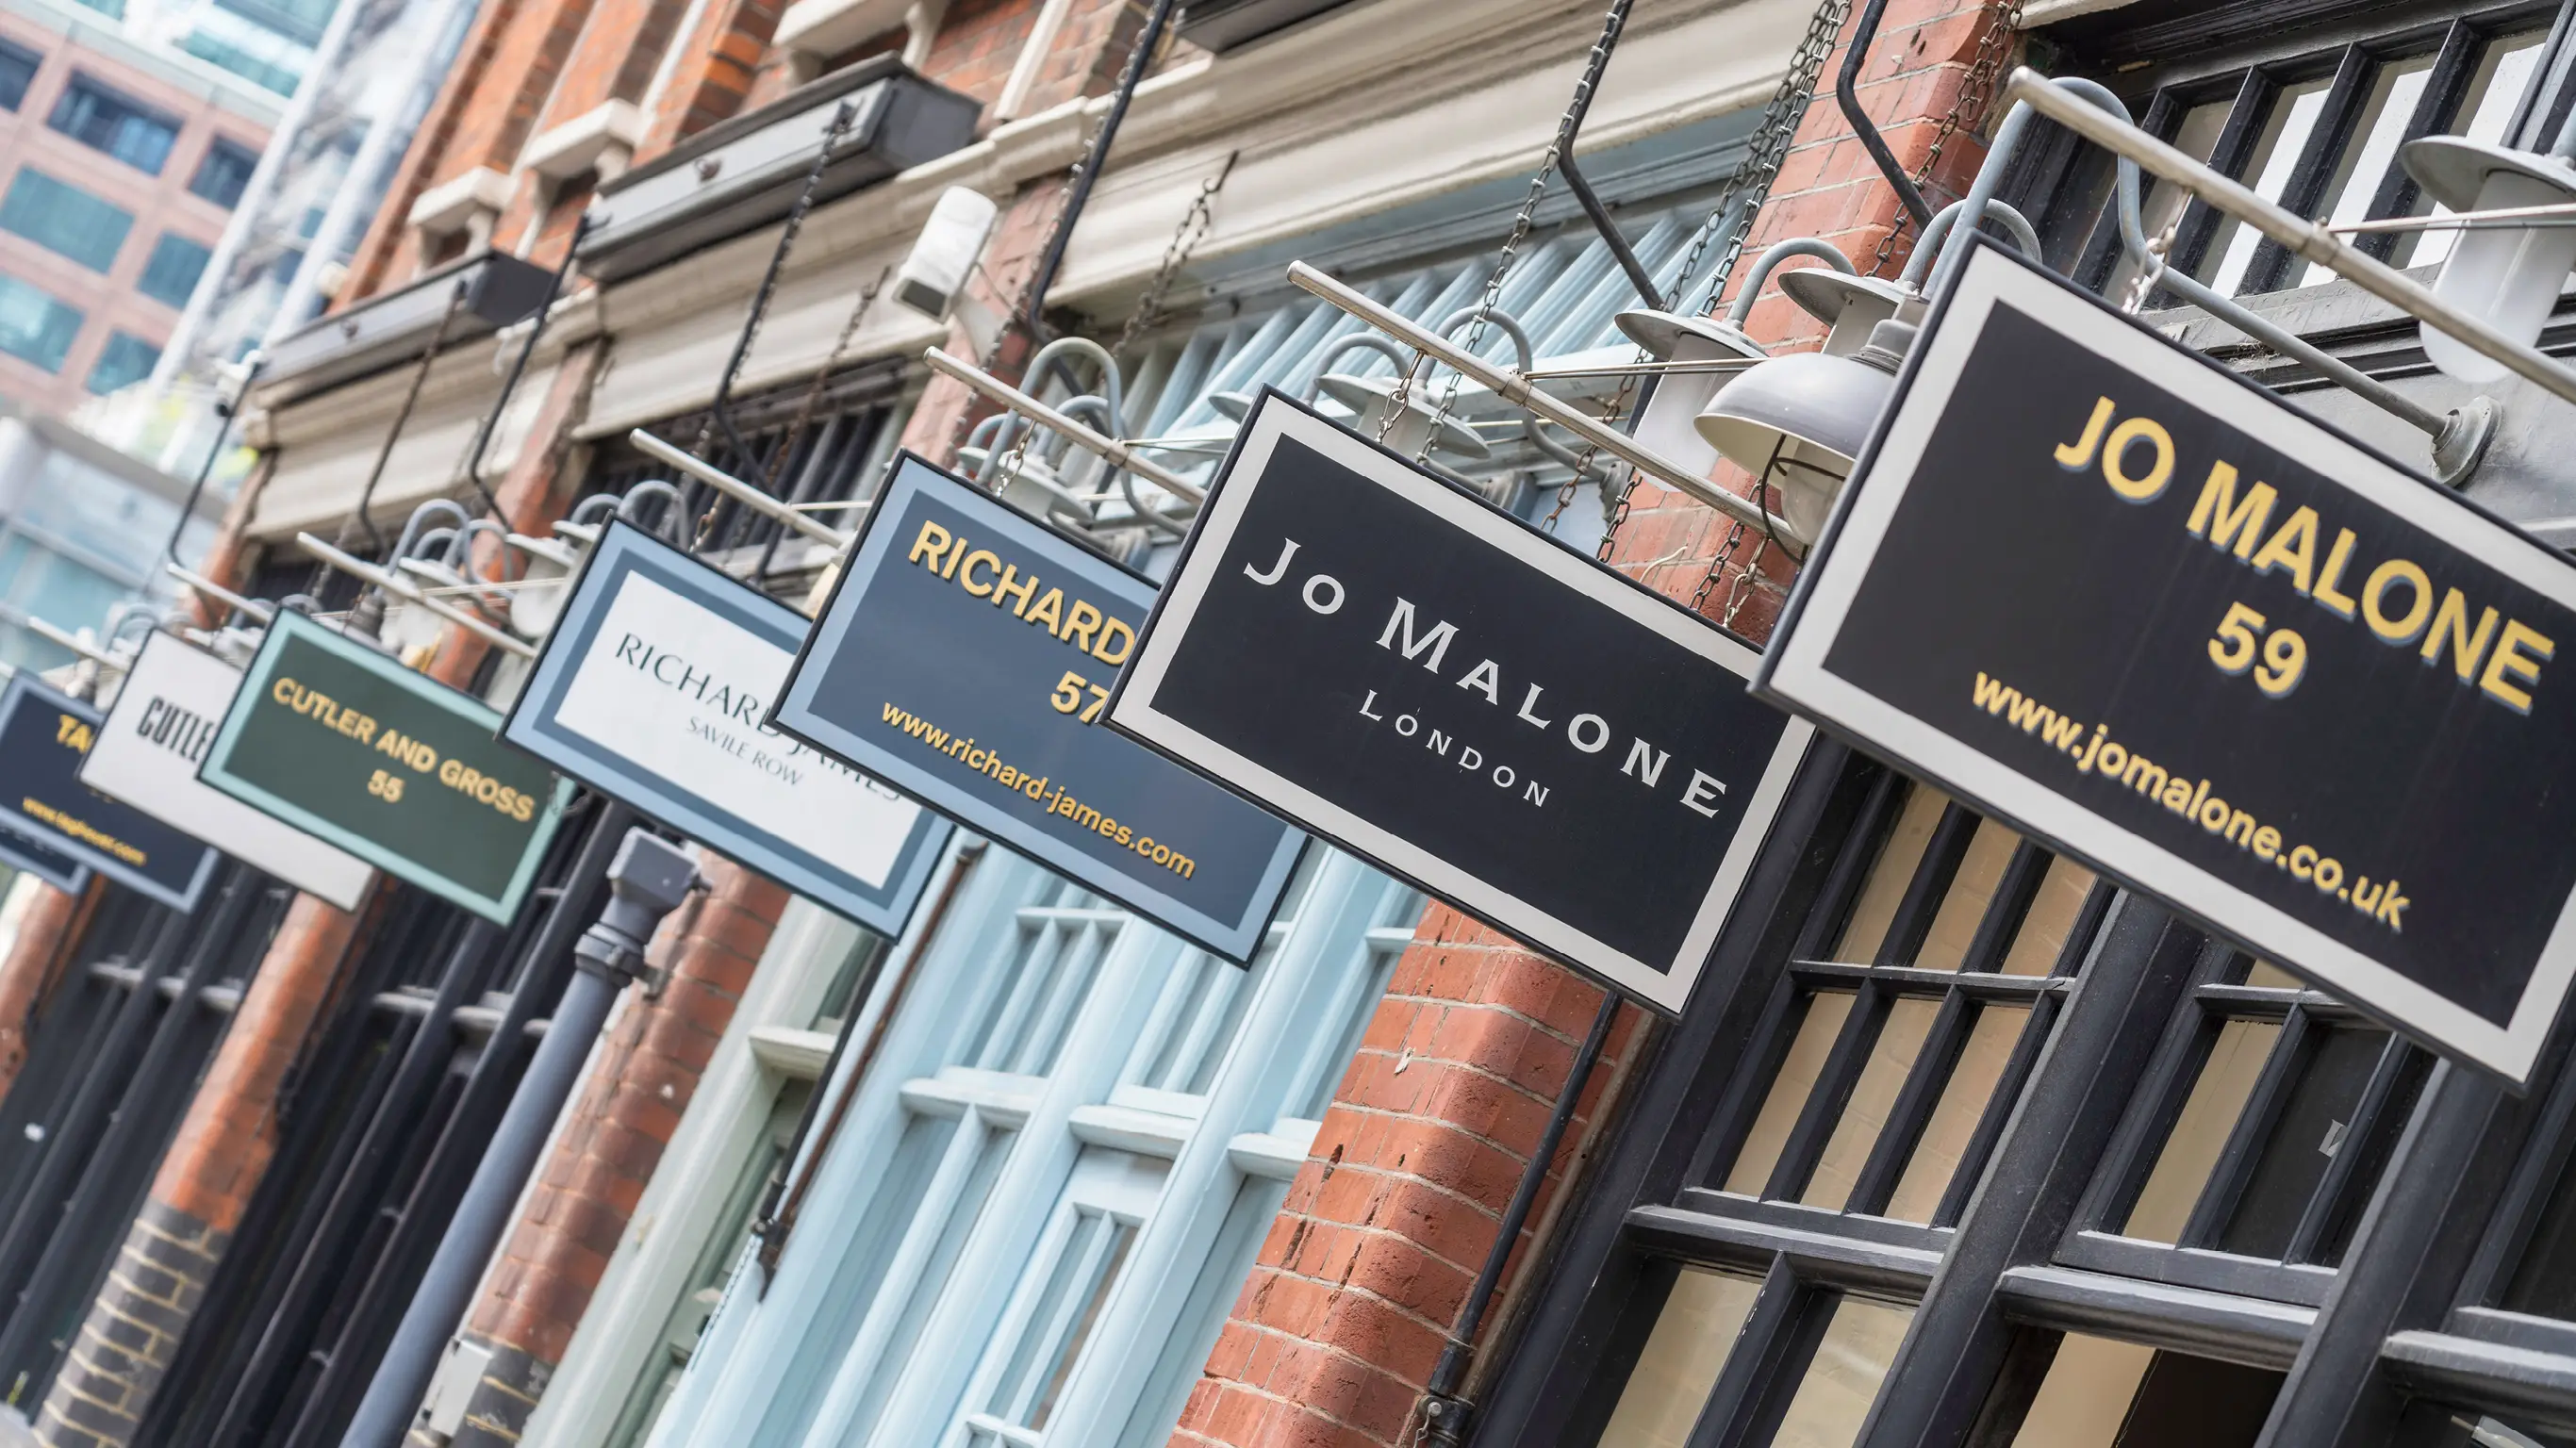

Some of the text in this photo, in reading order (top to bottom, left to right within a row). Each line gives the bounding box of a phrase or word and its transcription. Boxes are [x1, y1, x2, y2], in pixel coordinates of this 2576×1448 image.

[908, 519, 1135, 666] RICHARD
[2054, 395, 2556, 713] JO MALONE
[1050, 670, 1111, 724] 57
[1376, 596, 1728, 819] MALONE
[2208, 601, 2308, 696] 59
[57, 714, 95, 755] TA
[272, 677, 536, 823] CUTLER AND GROSS
[368, 769, 405, 803] 55
[686, 715, 750, 760] SAVILE
[752, 749, 804, 786] ROW
[882, 703, 1197, 880] www.richard-james.com
[1359, 689, 1551, 808] LONDON
[1973, 670, 2411, 933] www.jomalone.co.uk
